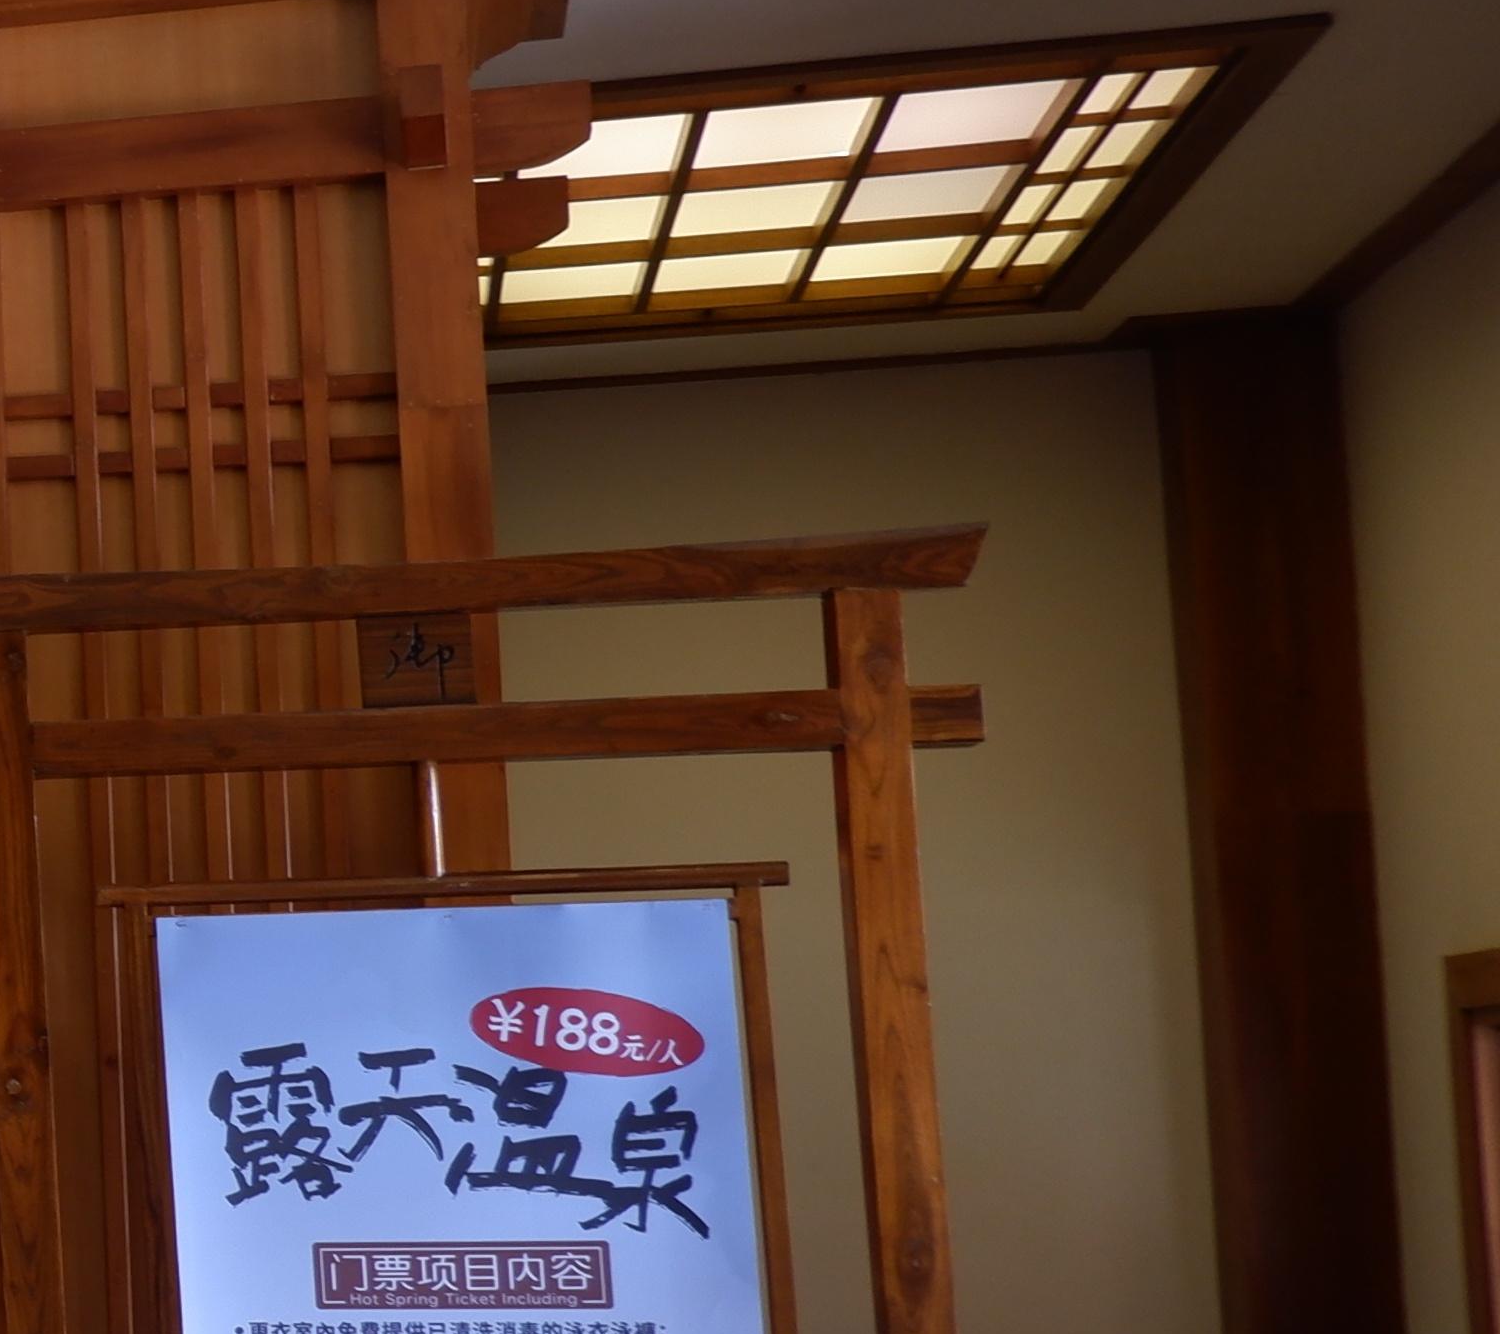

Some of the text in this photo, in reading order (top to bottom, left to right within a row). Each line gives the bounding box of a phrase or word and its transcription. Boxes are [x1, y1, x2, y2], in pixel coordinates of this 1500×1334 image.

[330, 1251, 595, 1292] 门票项目内容
[349, 1292, 579, 1308] Hot Spring Ticket Including
